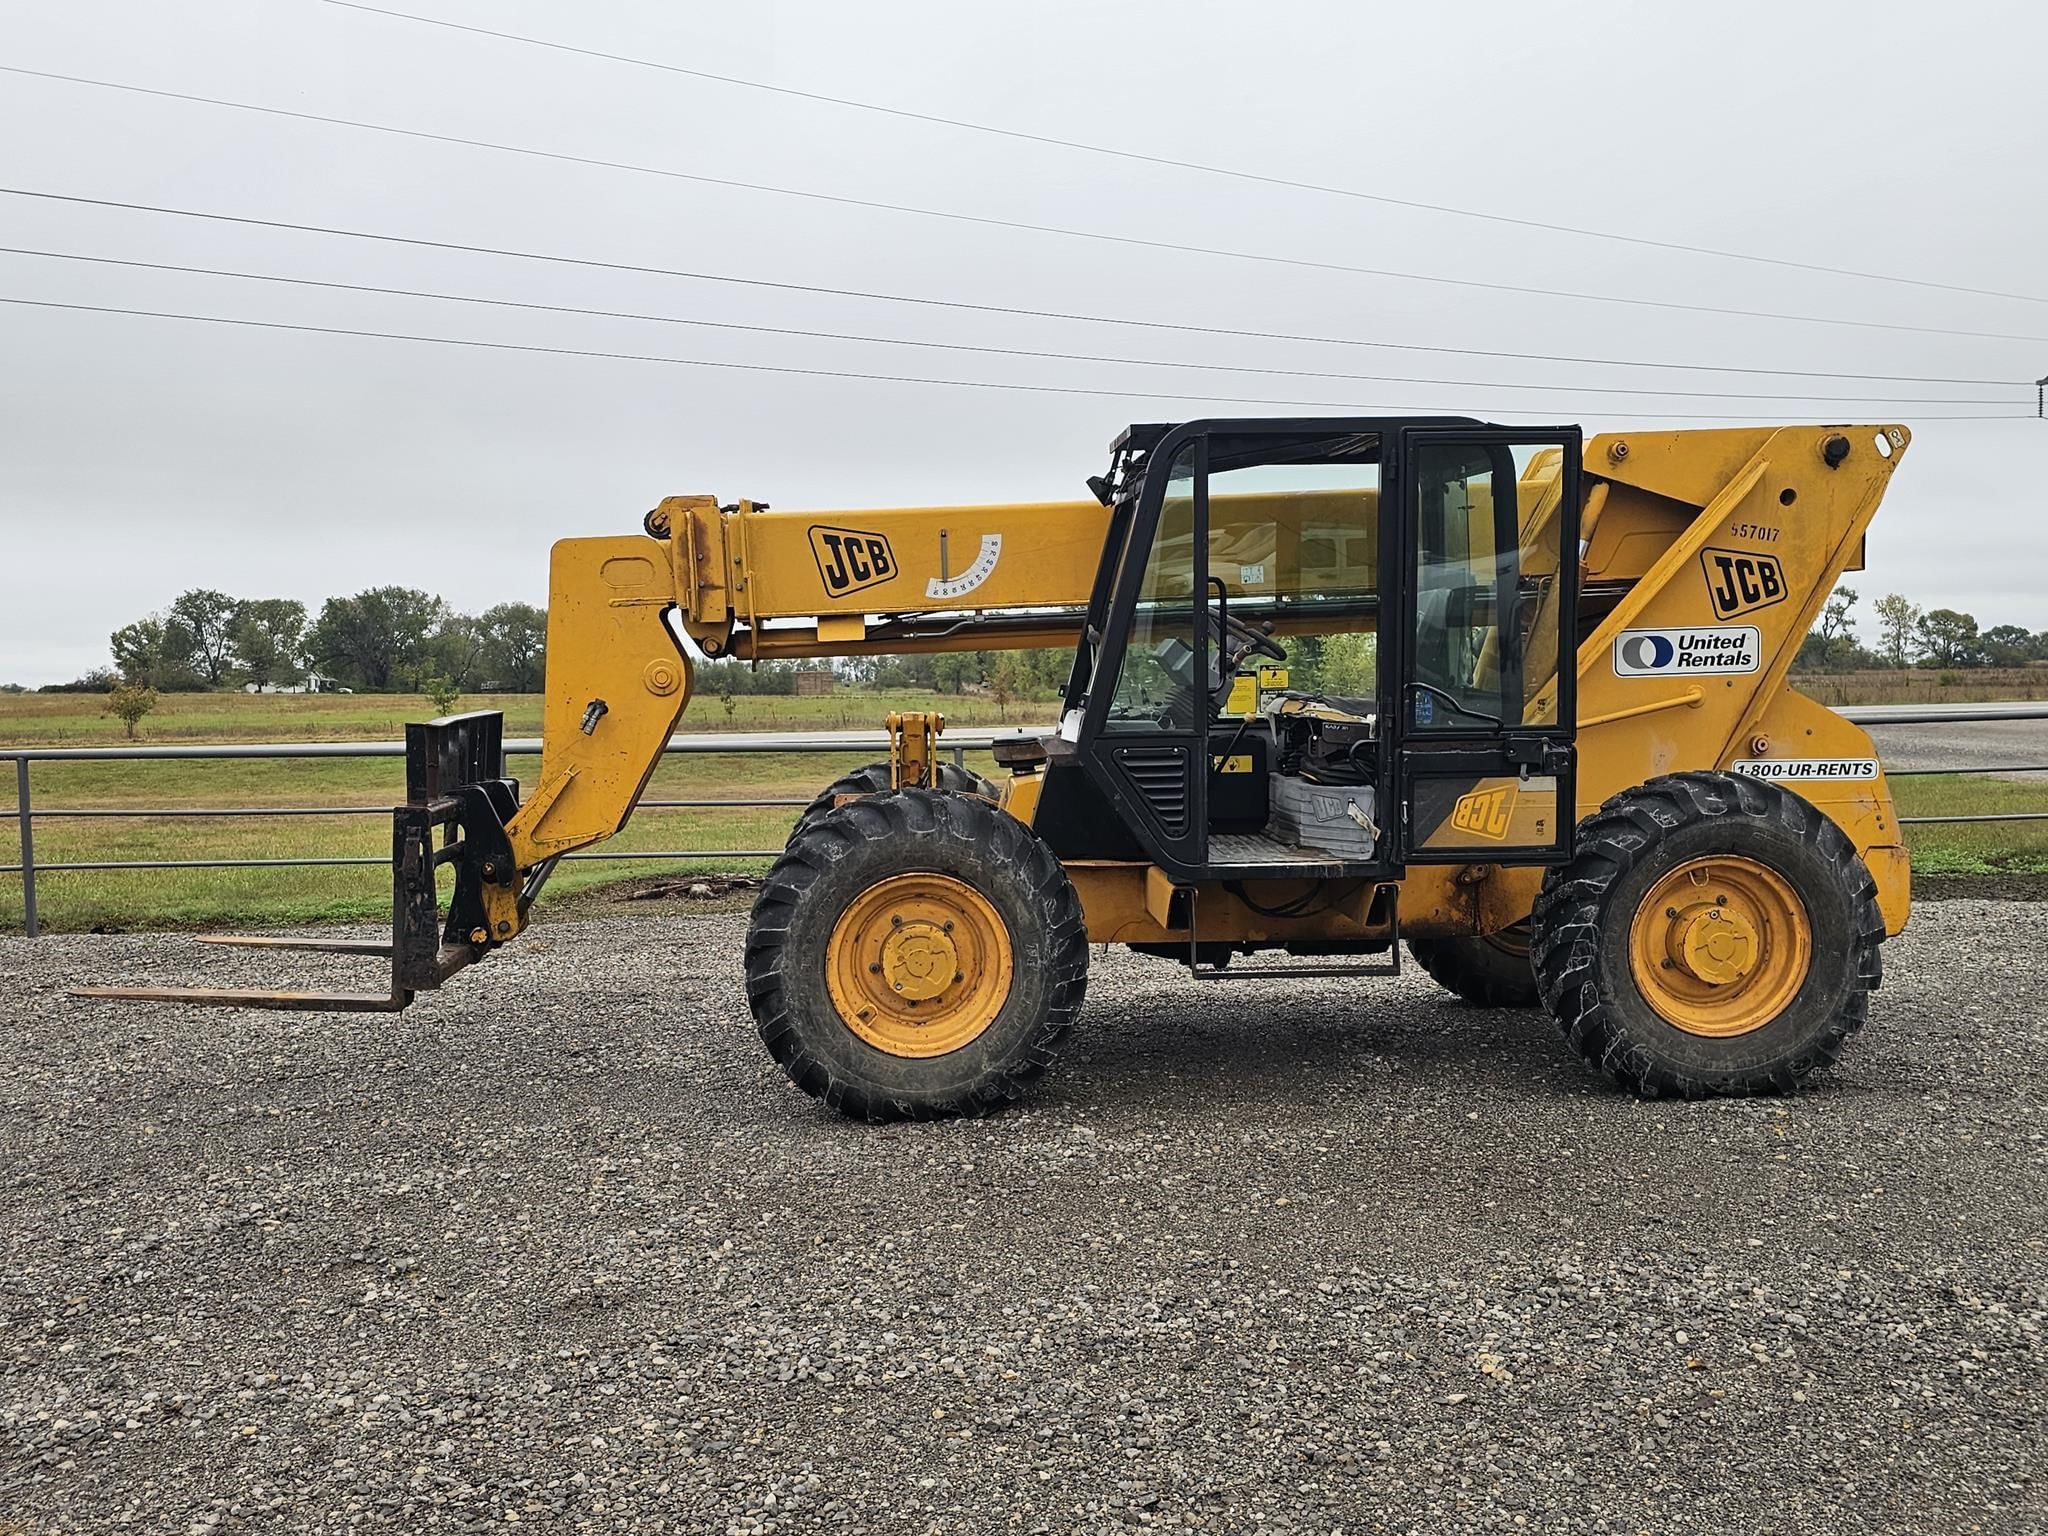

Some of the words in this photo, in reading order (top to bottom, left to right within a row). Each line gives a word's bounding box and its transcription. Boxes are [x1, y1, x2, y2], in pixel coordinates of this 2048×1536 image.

[822, 534, 890, 590] JCB
[1714, 556, 1780, 612] JCB
[1678, 633, 1747, 650] United
[1677, 651, 1752, 668] Rentals
[1737, 762, 1873, 777] 1-800-UR-RENTS
